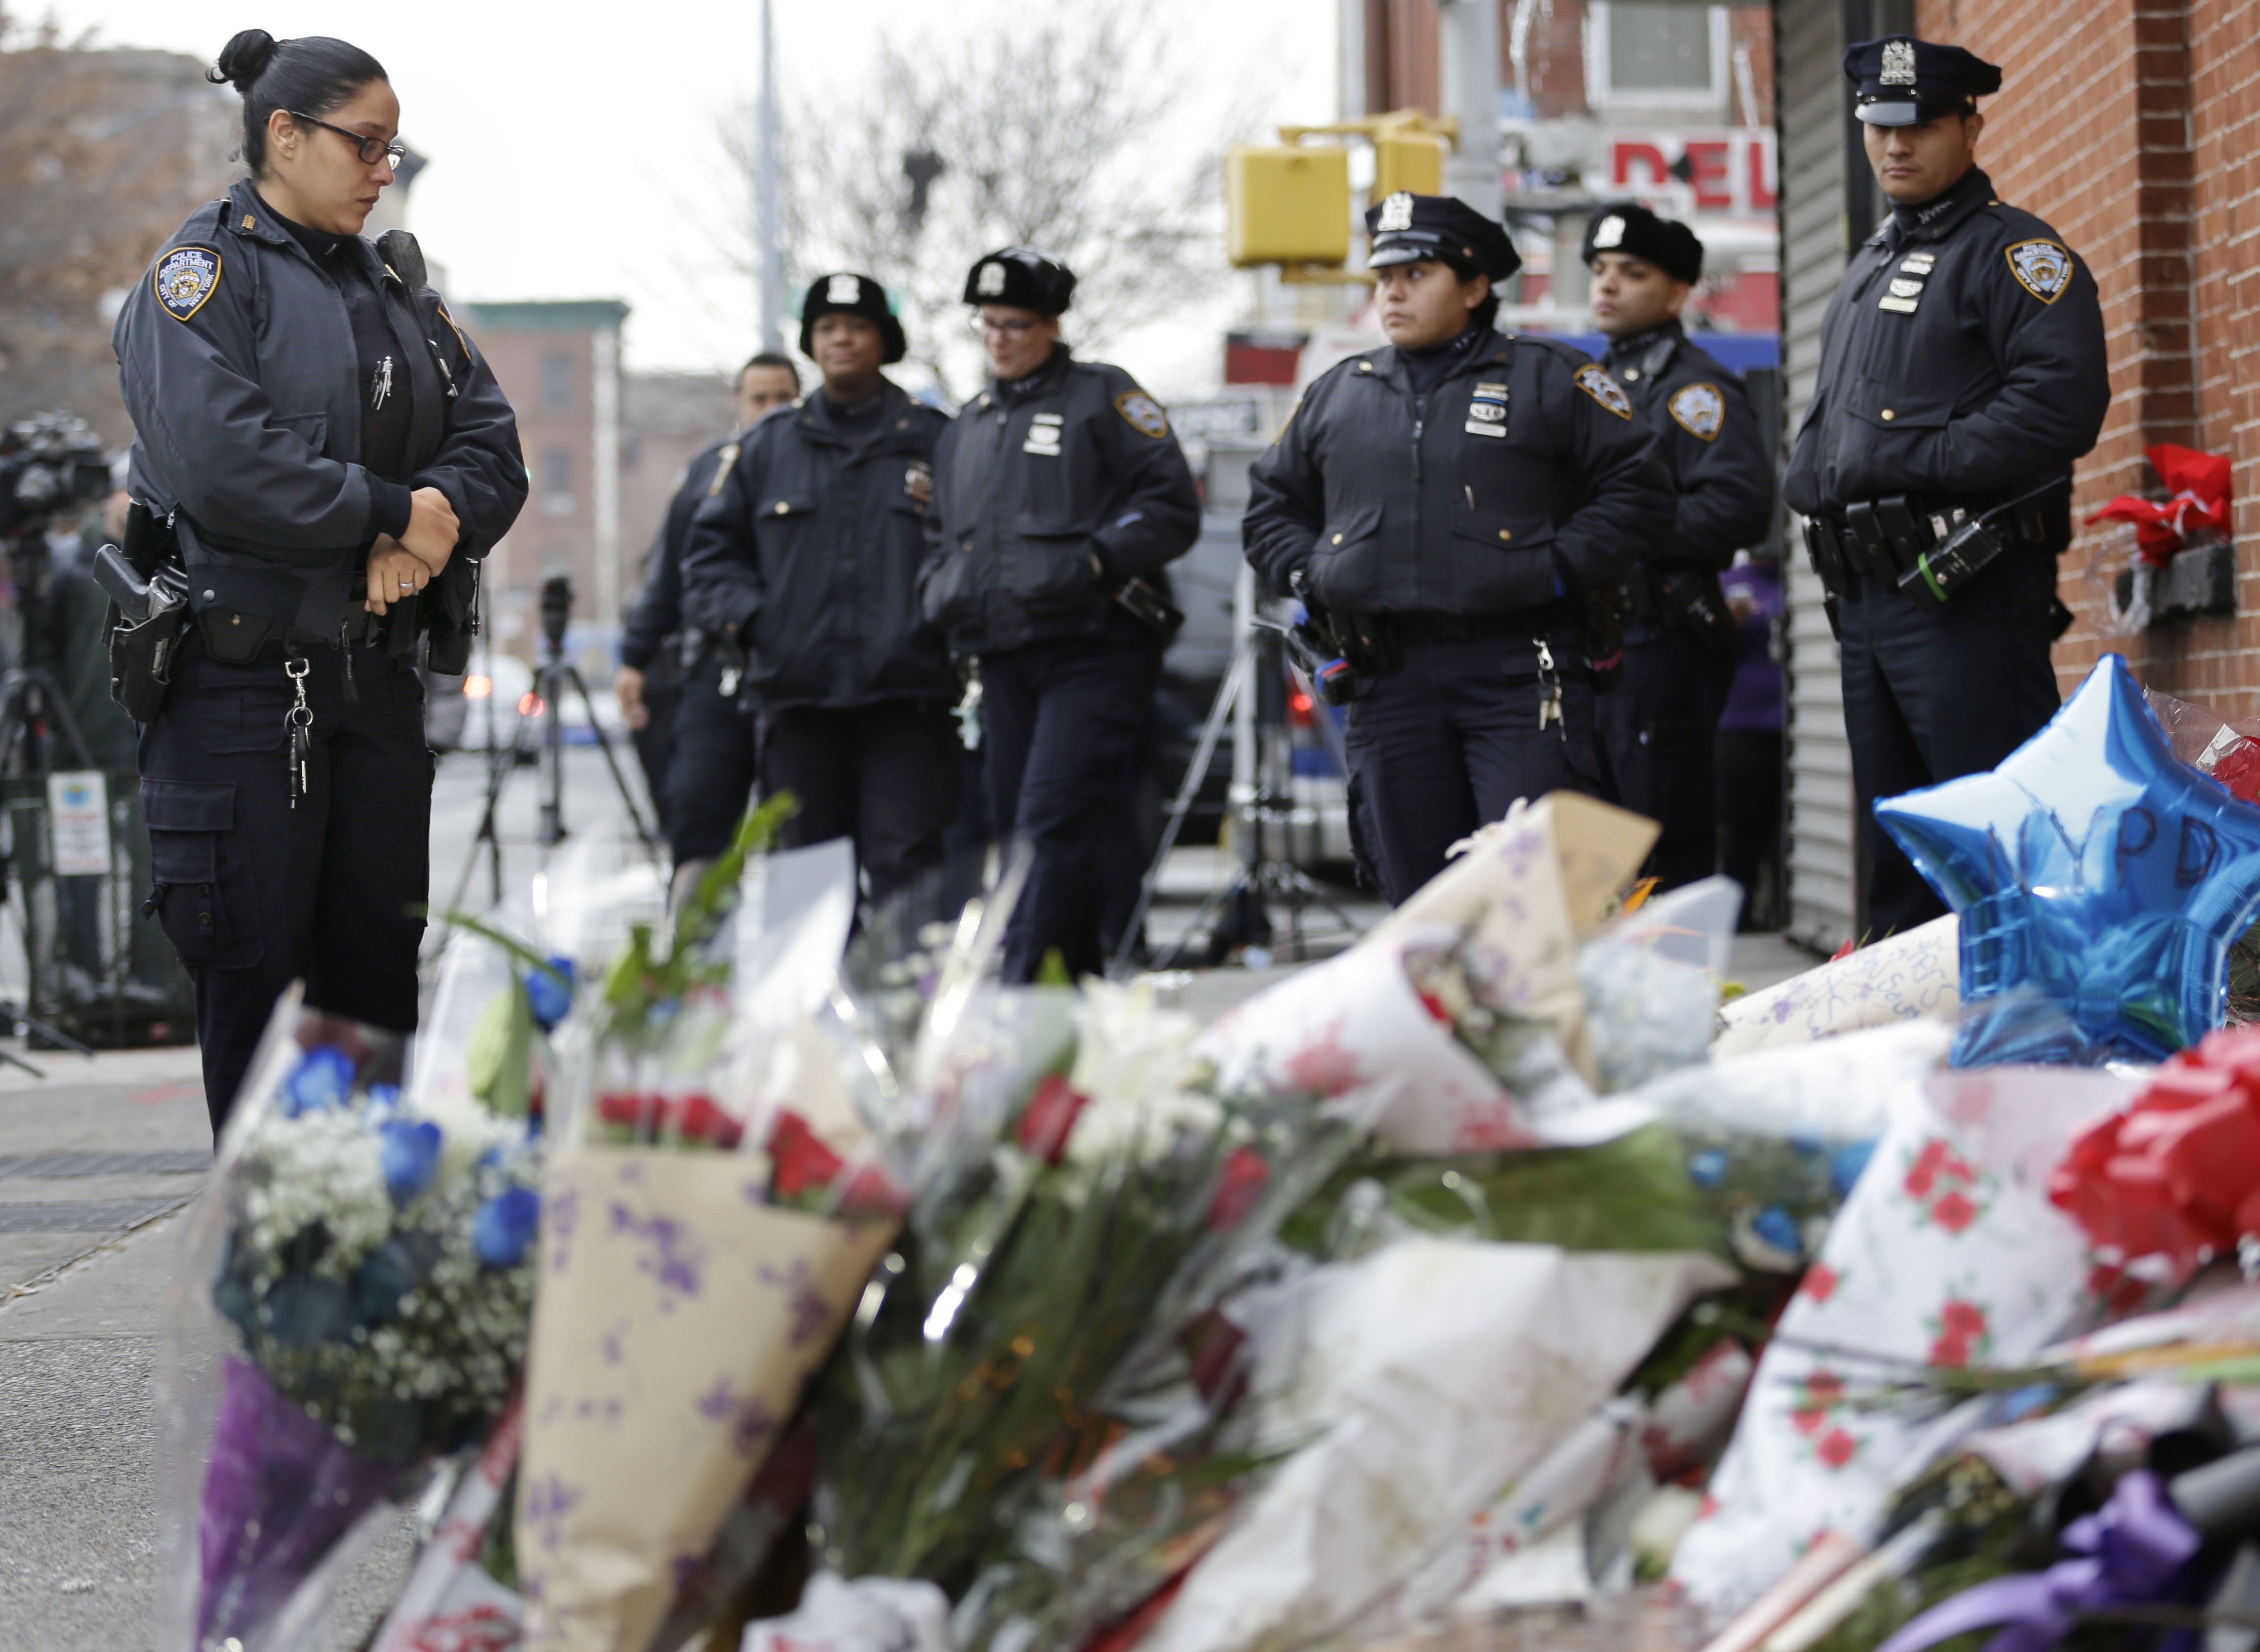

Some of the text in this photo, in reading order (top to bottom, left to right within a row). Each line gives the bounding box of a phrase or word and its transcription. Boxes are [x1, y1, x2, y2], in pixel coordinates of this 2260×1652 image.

[159, 259, 214, 279] DEPARTMENT
[170, 251, 203, 263] POLICE
[159, 283, 178, 308] CITY OF
[189, 274, 215, 307] NEW YORK
[1987, 806, 2217, 897] NYPD
